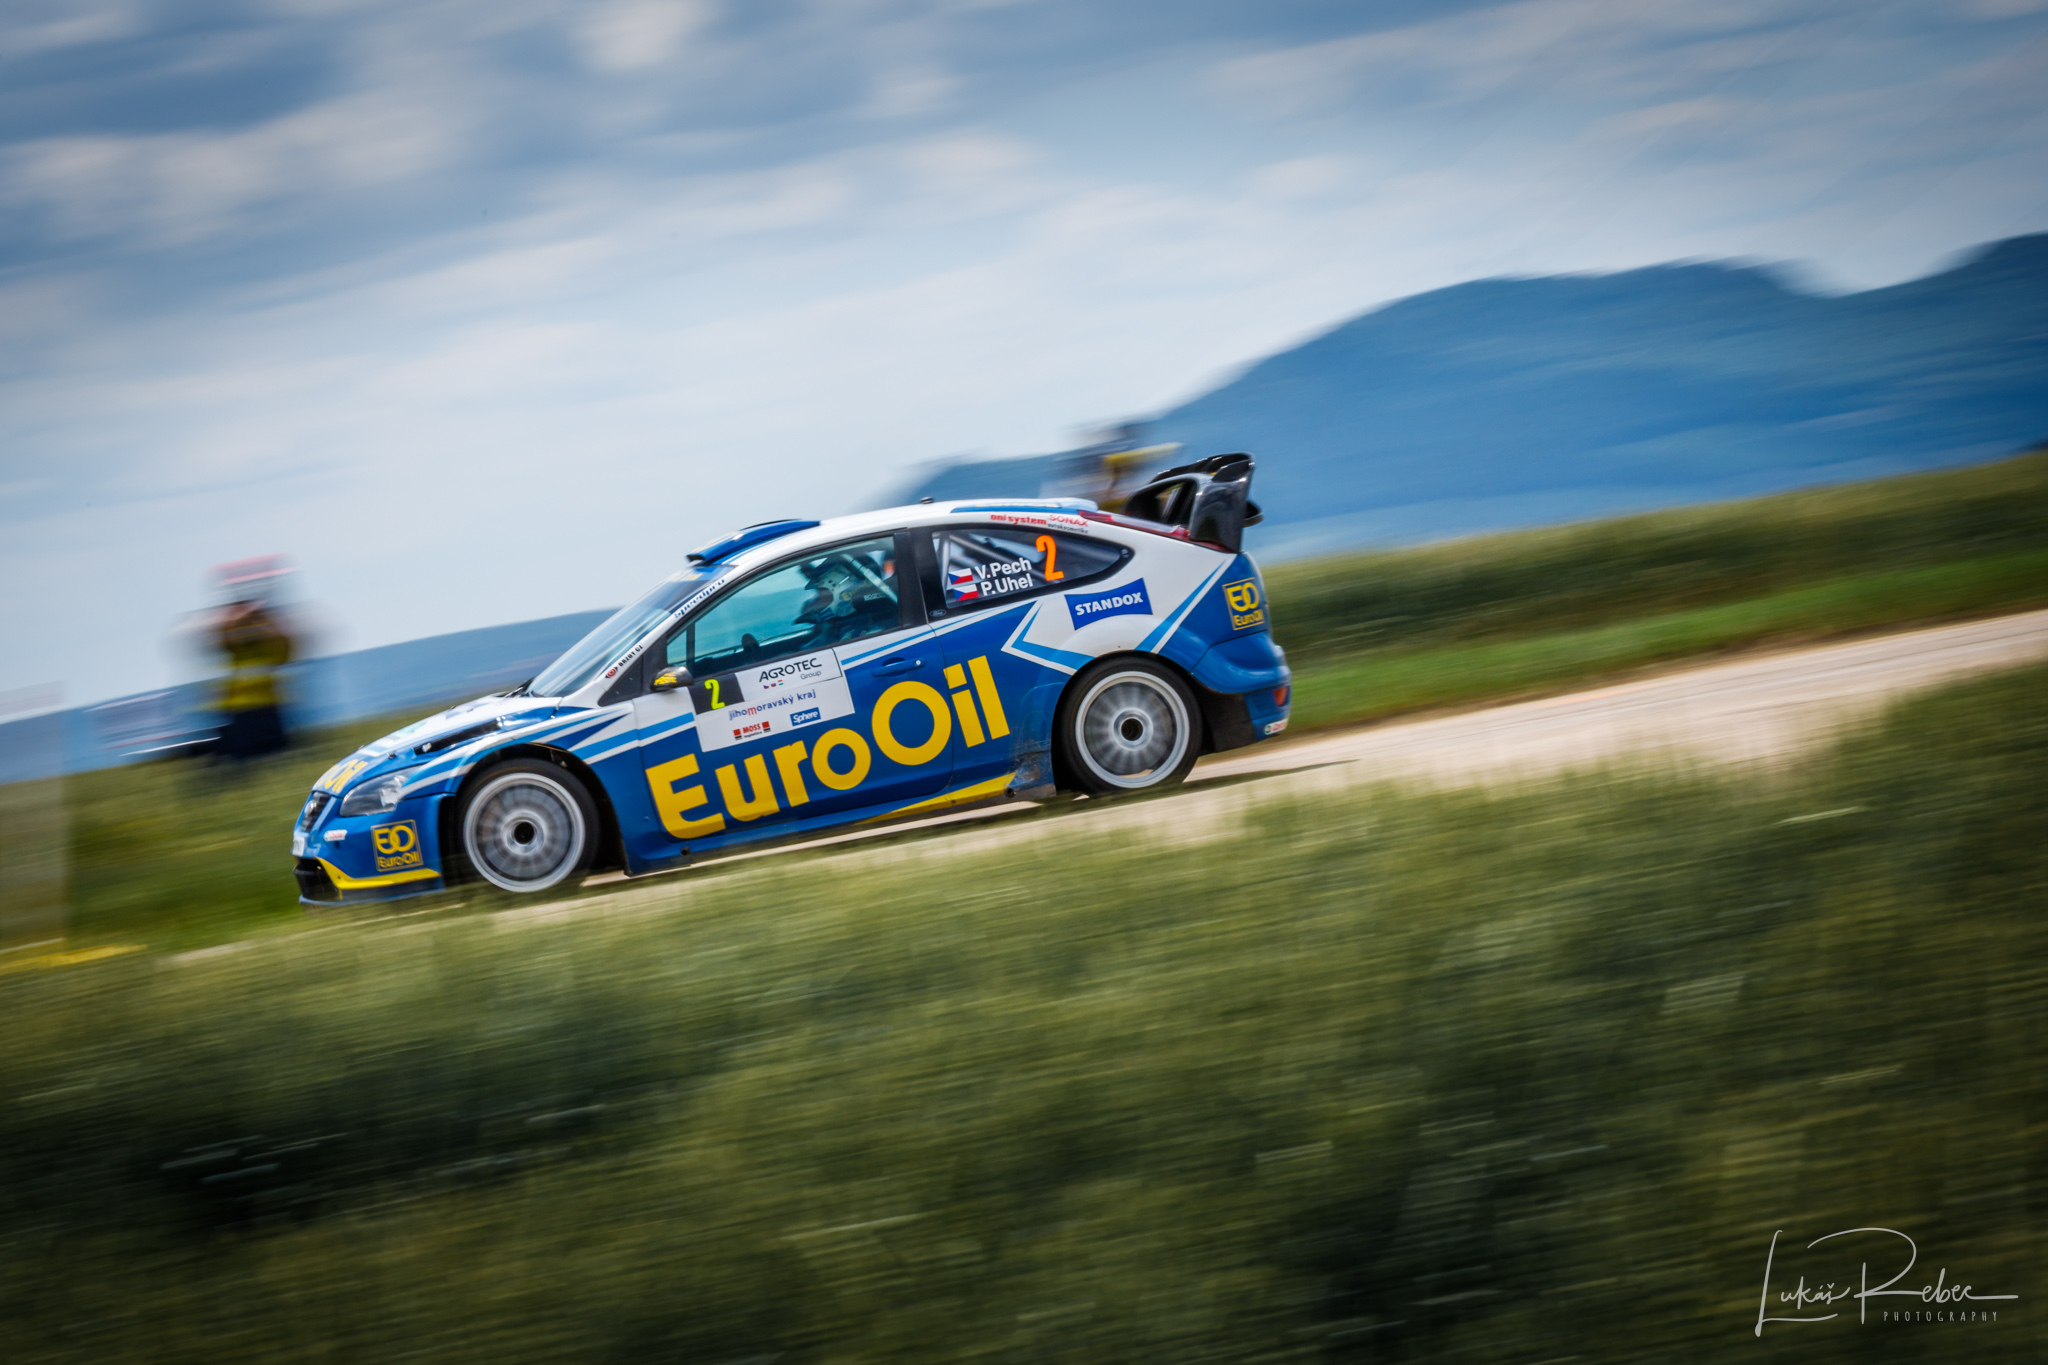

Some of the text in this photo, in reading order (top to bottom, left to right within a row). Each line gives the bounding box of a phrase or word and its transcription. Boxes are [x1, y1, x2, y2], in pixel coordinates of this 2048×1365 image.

[1008, 516, 1047, 525] system
[1048, 514, 1089, 527] SONAX
[974, 557, 1032, 580] V.Pech
[1035, 535, 1064, 581] 2
[980, 574, 1033, 596] P.Uhel
[1075, 592, 1143, 616] STANDOX
[759, 658, 822, 682] AGROTEC
[800, 670, 821, 680] Group
[704, 679, 726, 710] 2
[728, 689, 816, 720] jihomoravský kraj
[742, 722, 761, 734] MOSS
[792, 711, 818, 724] Sphere
[645, 655, 1010, 839] EuroOil
[377, 851, 419, 868] EuroOil
